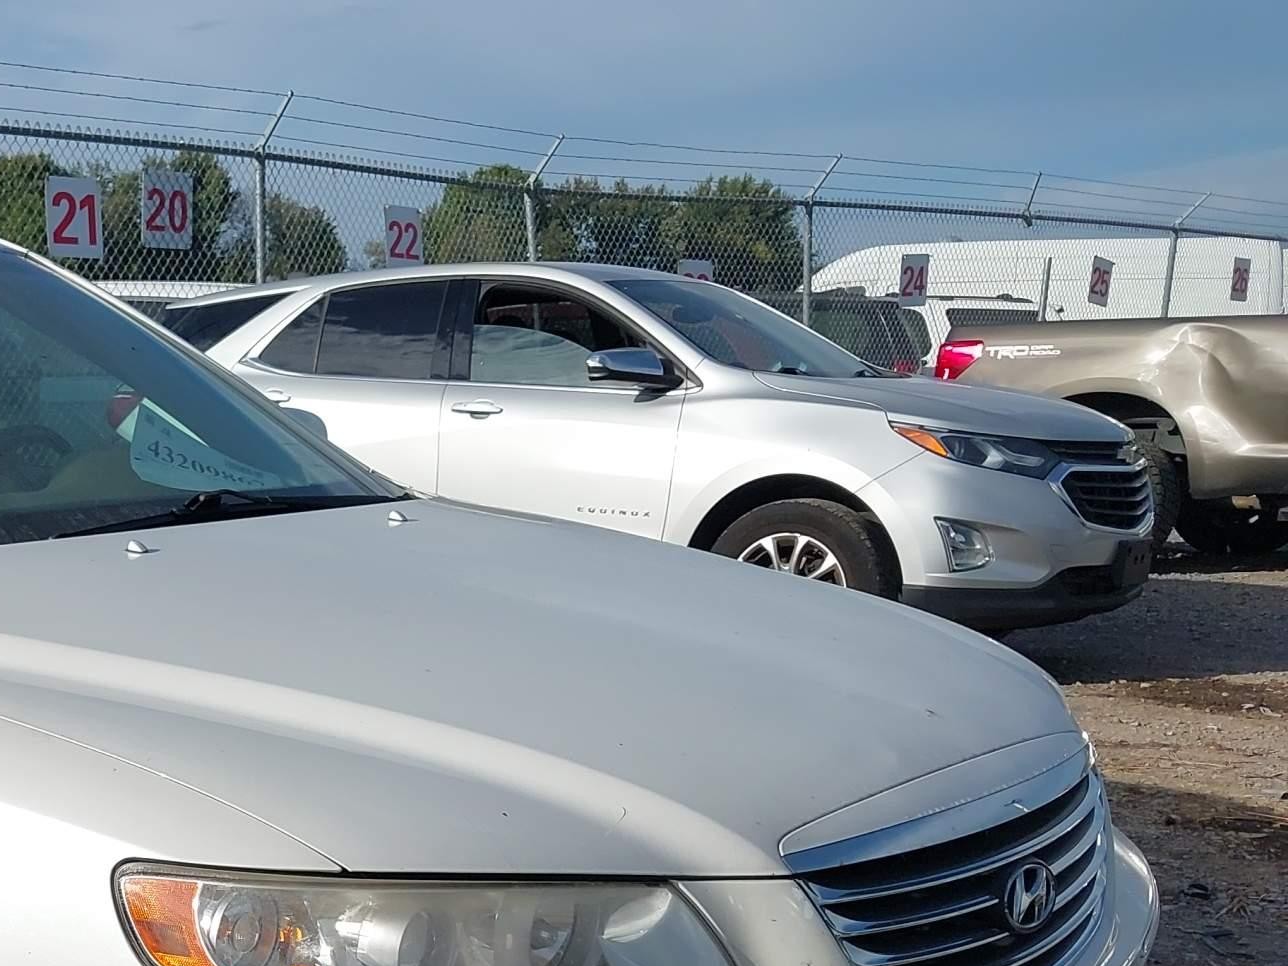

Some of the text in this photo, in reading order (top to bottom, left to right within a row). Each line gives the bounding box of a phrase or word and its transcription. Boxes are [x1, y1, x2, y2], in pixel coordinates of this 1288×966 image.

[52, 191, 98, 247] 21
[146, 187, 188, 234] 20
[388, 220, 420, 261] 22
[901, 265, 926, 297] 24
[1090, 267, 1111, 298] 25
[1231, 267, 1248, 294] 26
[985, 345, 1030, 360] TRD
[576, 506, 651, 518] EQUINOX
